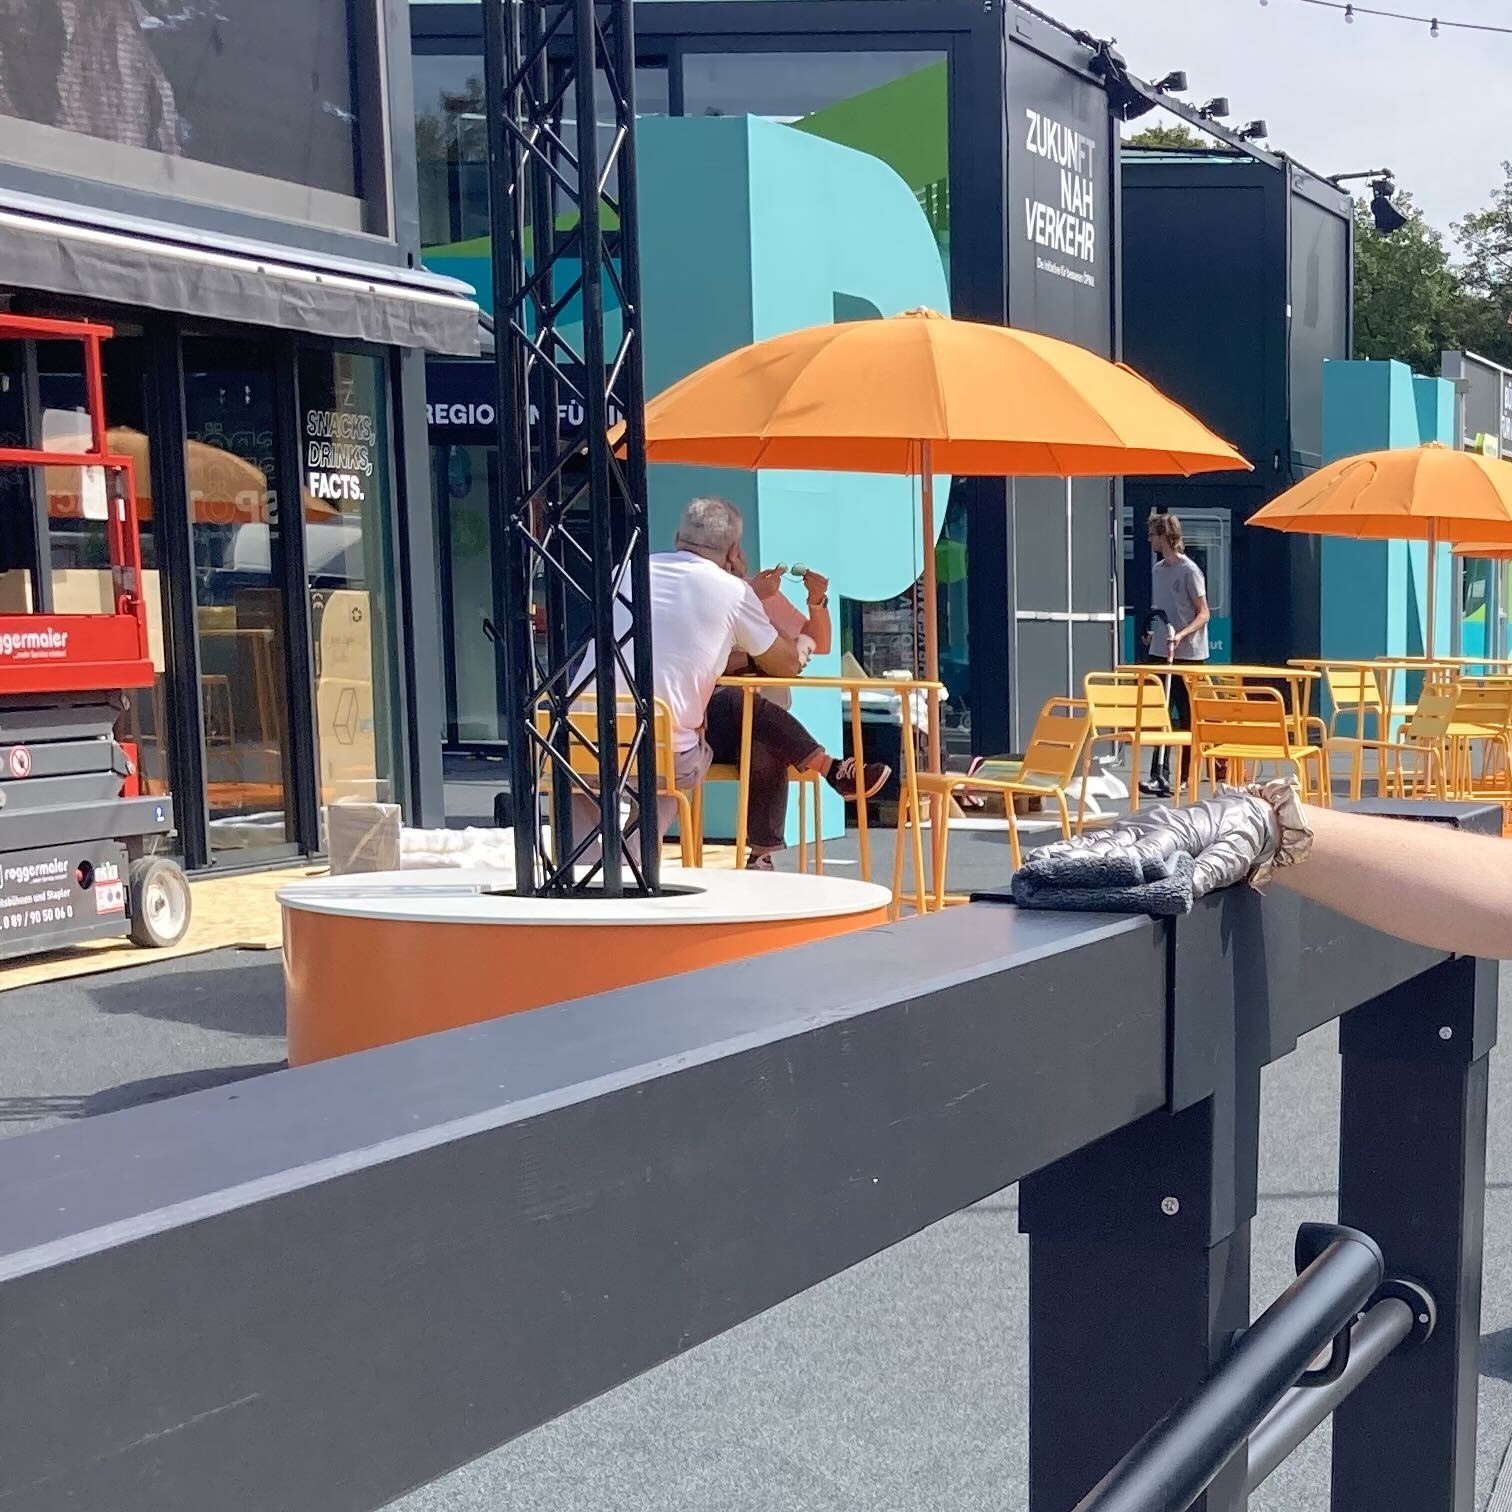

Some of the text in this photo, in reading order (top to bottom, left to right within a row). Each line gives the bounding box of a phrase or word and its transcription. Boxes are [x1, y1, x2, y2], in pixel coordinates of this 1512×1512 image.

[1026, 108, 1095, 178] ZUKUNFT
[1060, 168, 1094, 220] NAH
[1025, 198, 1095, 263] VERKEHR
[306, 409, 376, 447] SNACKS,
[307, 440, 373, 477] DRINKS,
[309, 471, 365, 500] FACTS.
